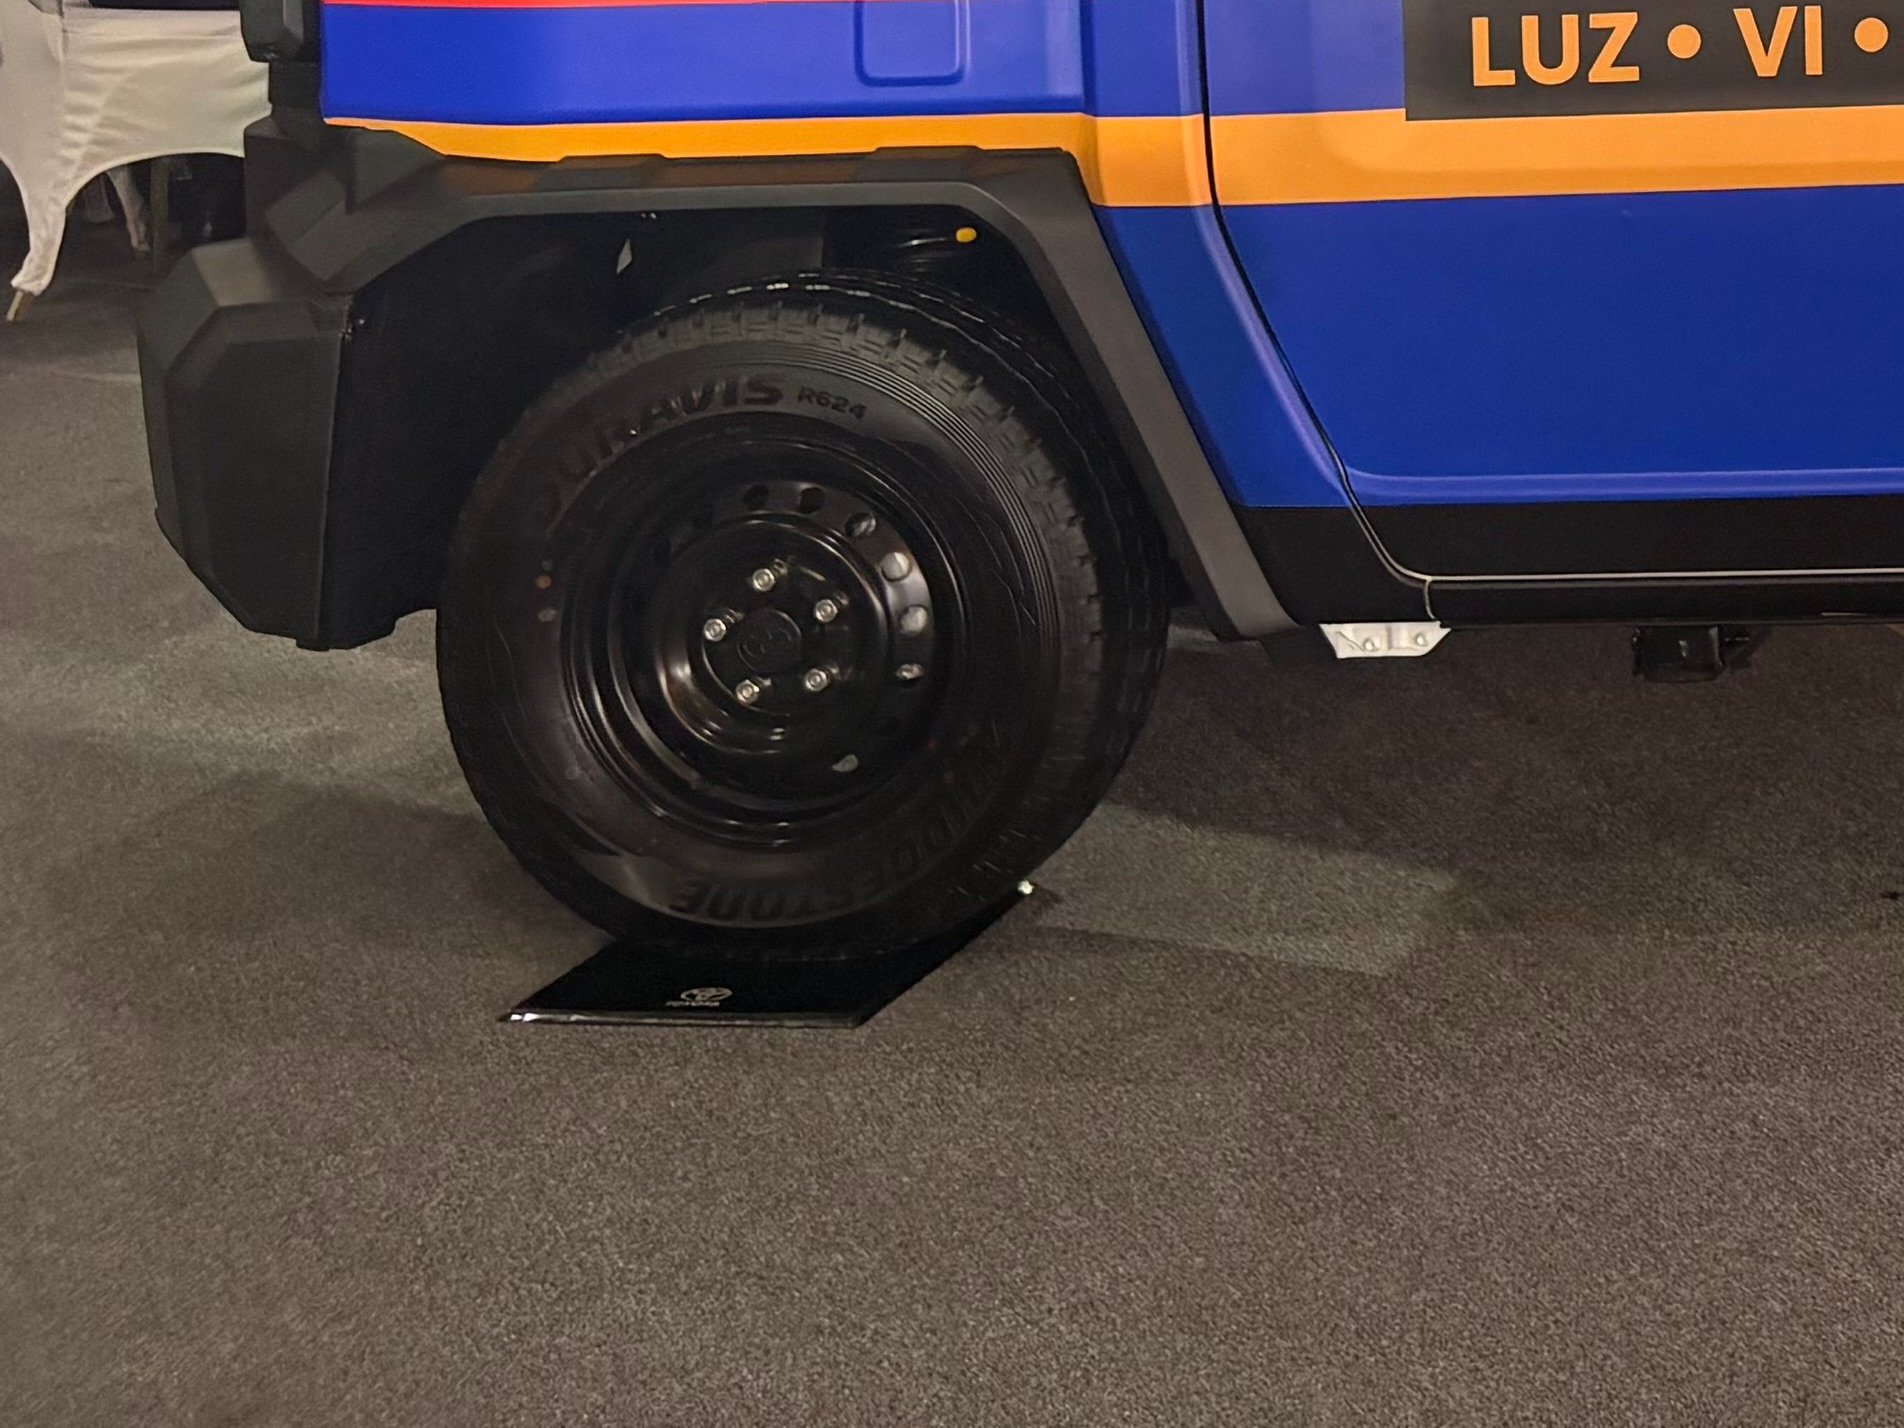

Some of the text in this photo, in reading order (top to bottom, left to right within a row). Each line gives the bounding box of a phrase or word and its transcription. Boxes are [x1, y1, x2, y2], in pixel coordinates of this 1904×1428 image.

[1472, 12, 1640, 87] LUZ
[1735, 7, 1823, 77] VI
[796, 384, 868, 421] R624
